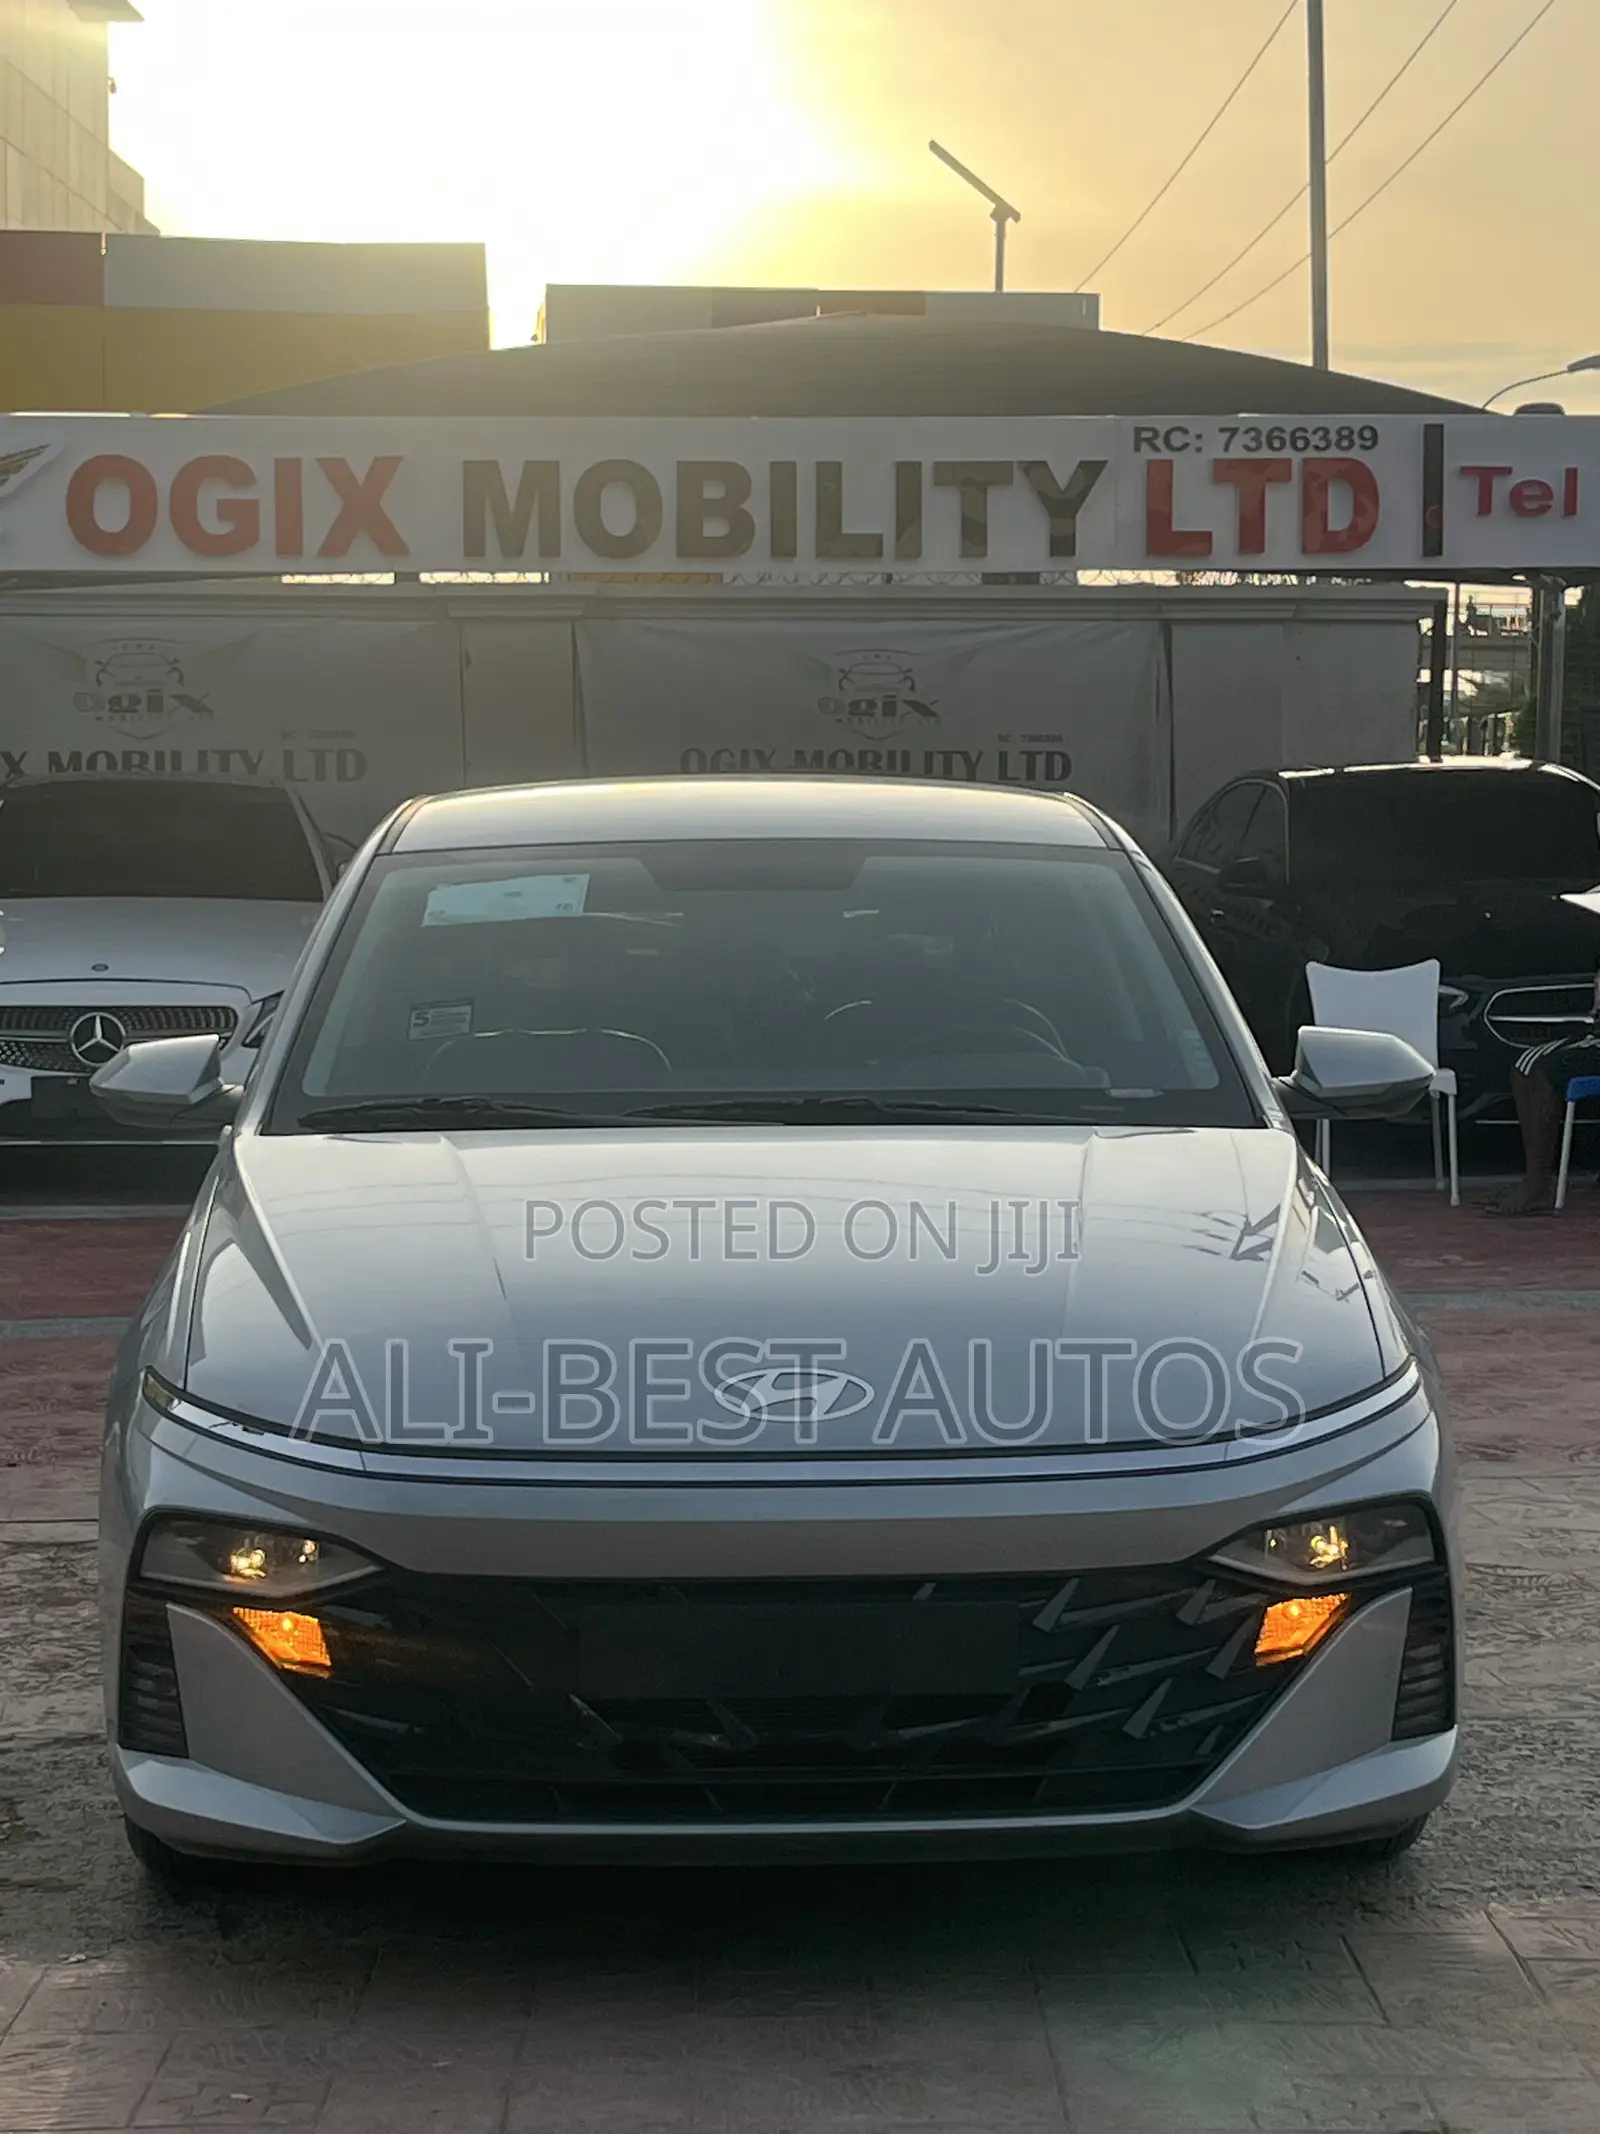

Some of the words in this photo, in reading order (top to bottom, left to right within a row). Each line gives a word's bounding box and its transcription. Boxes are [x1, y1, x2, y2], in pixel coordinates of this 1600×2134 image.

[1133, 426, 1203, 453] RC:
[1218, 424, 1379, 453] 7366389
[66, 453, 411, 558] OGIX
[461, 458, 1109, 559] MOBILITY
[1146, 456, 1380, 555] LTD
[1459, 465, 1579, 518] Tel
[282, 748, 369, 783] LTD
[998, 750, 1073, 782] LTD
